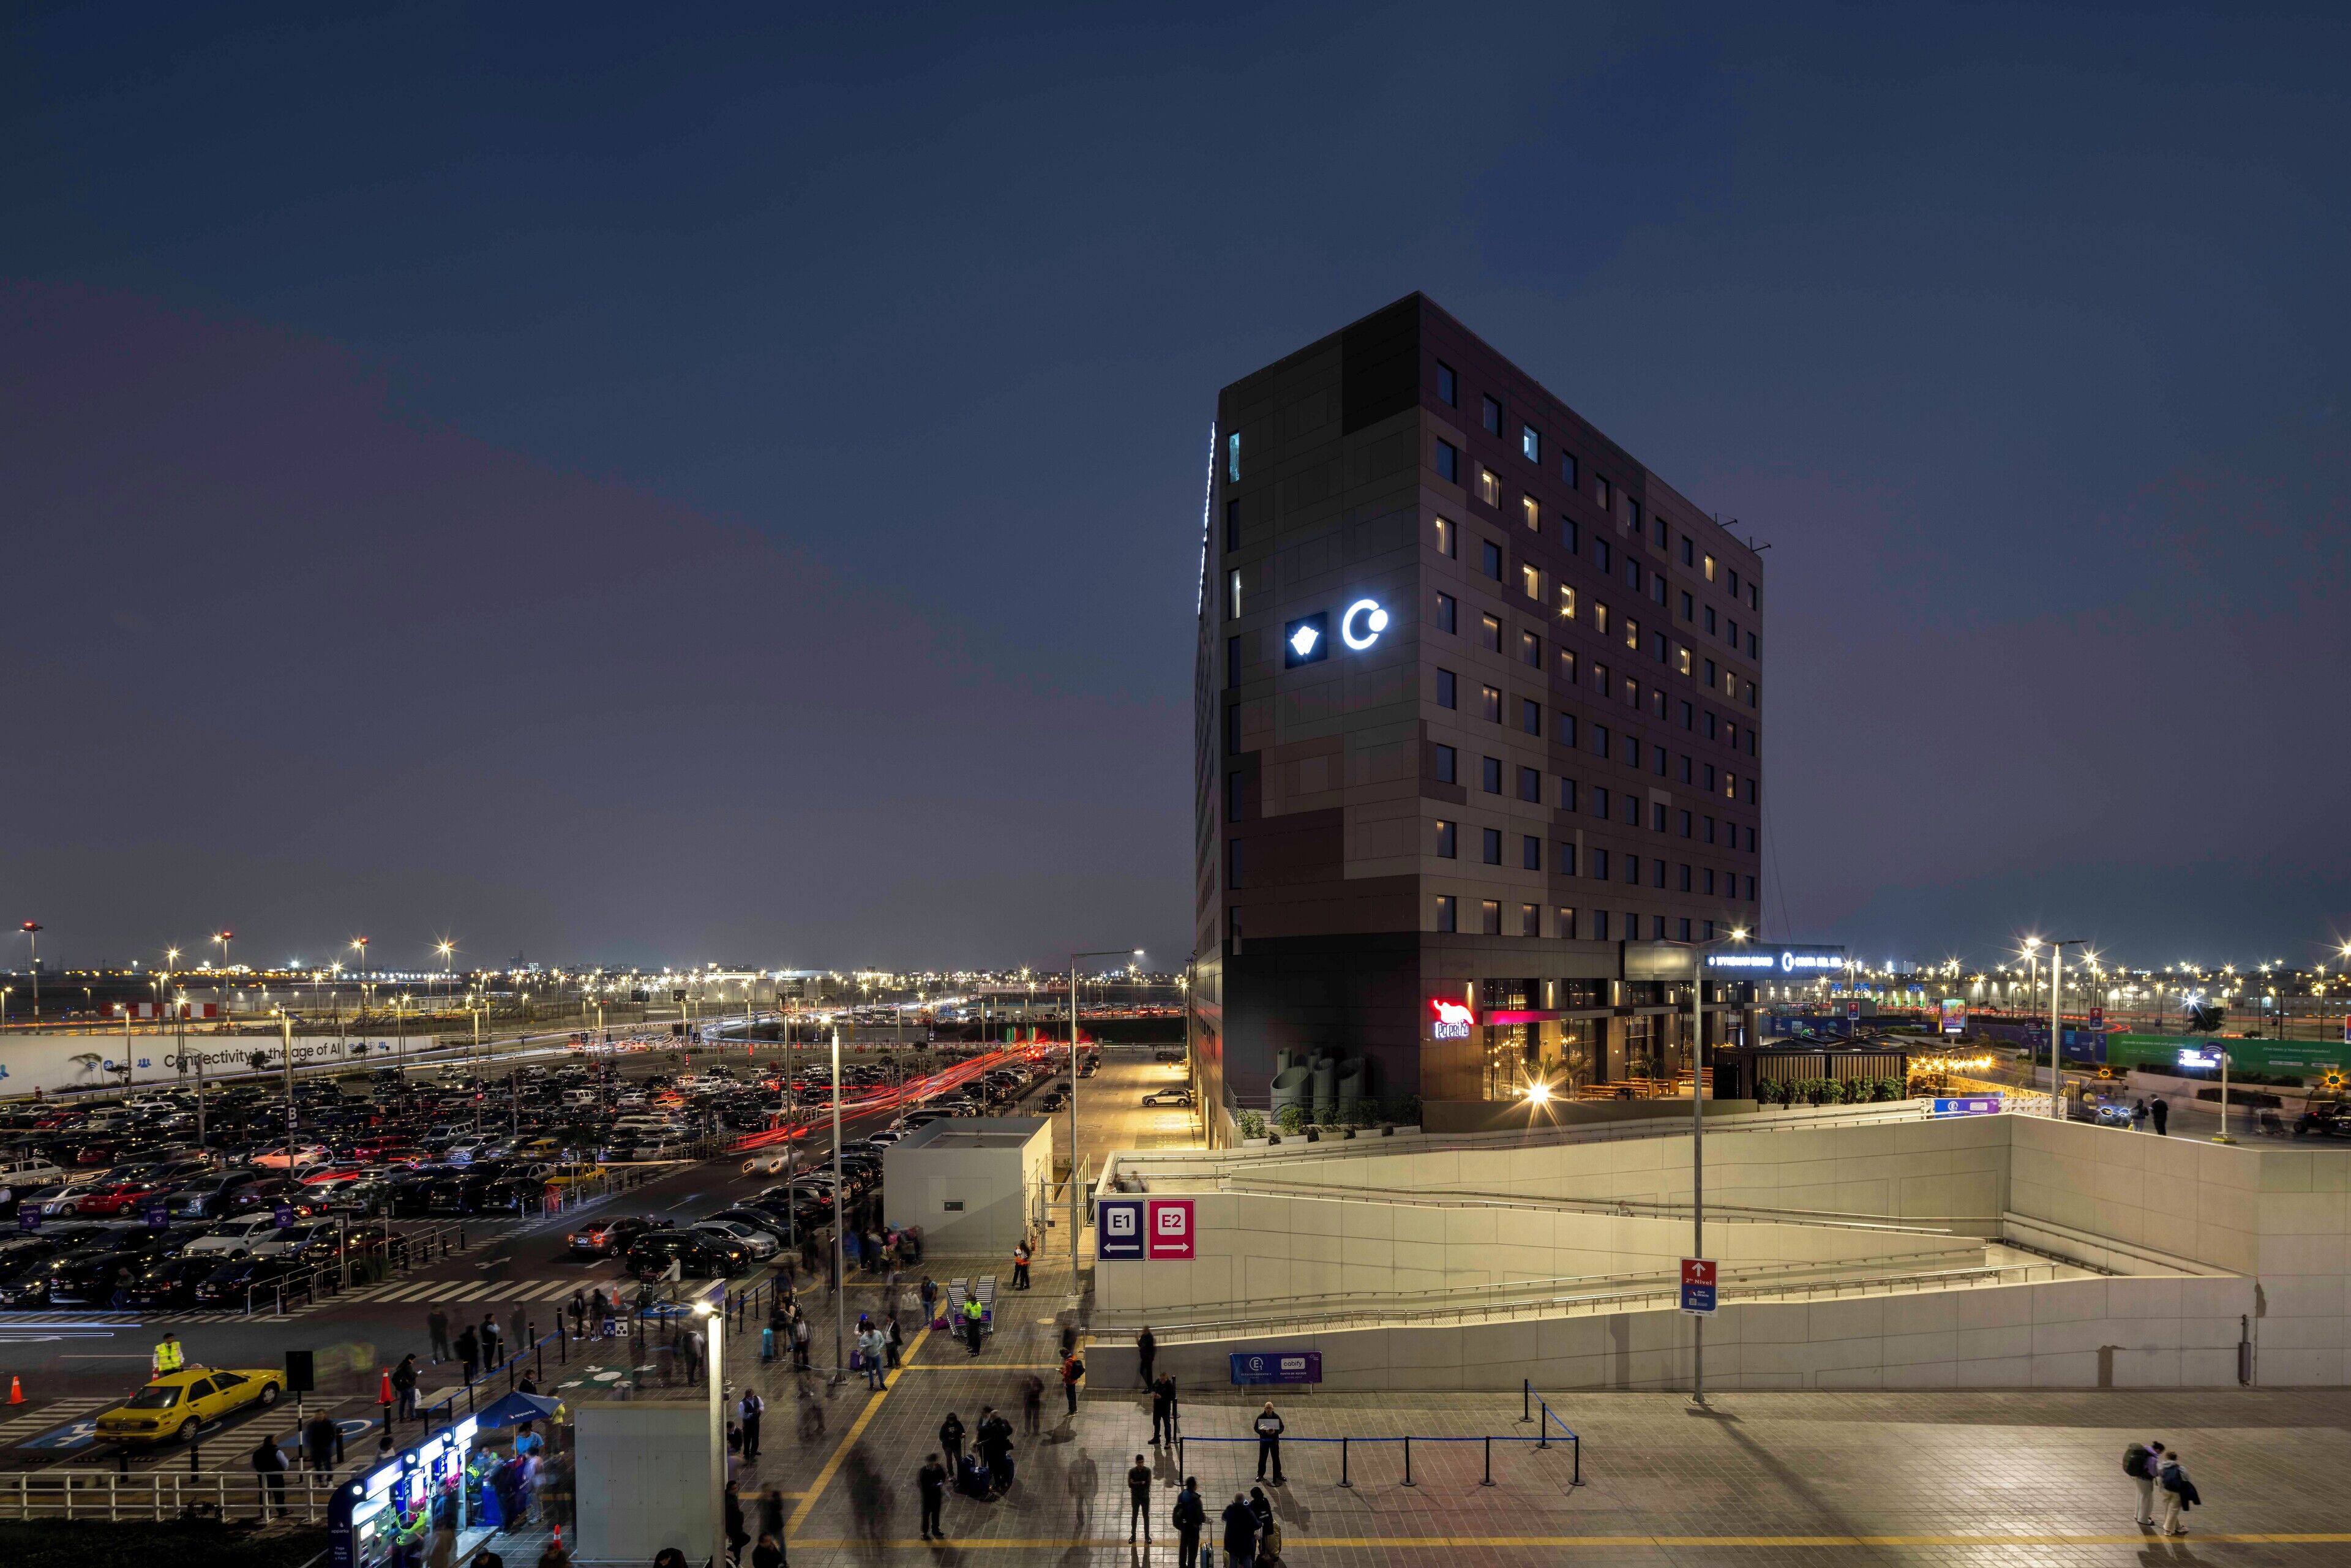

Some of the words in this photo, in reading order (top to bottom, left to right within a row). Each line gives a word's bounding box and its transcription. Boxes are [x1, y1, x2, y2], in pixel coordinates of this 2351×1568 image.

[165, 1048, 252, 1067] Cnectivity
[291, 1047, 313, 1060] age
[317, 1043, 328, 1055] of
[330, 1043, 340, 1054] AI
[601, 1065, 605, 1073] D
[477, 1081, 483, 1092] C
[288, 1106, 297, 1120] B
[1113, 1215, 1130, 1228] E1
[1162, 1214, 1181, 1228] E2
